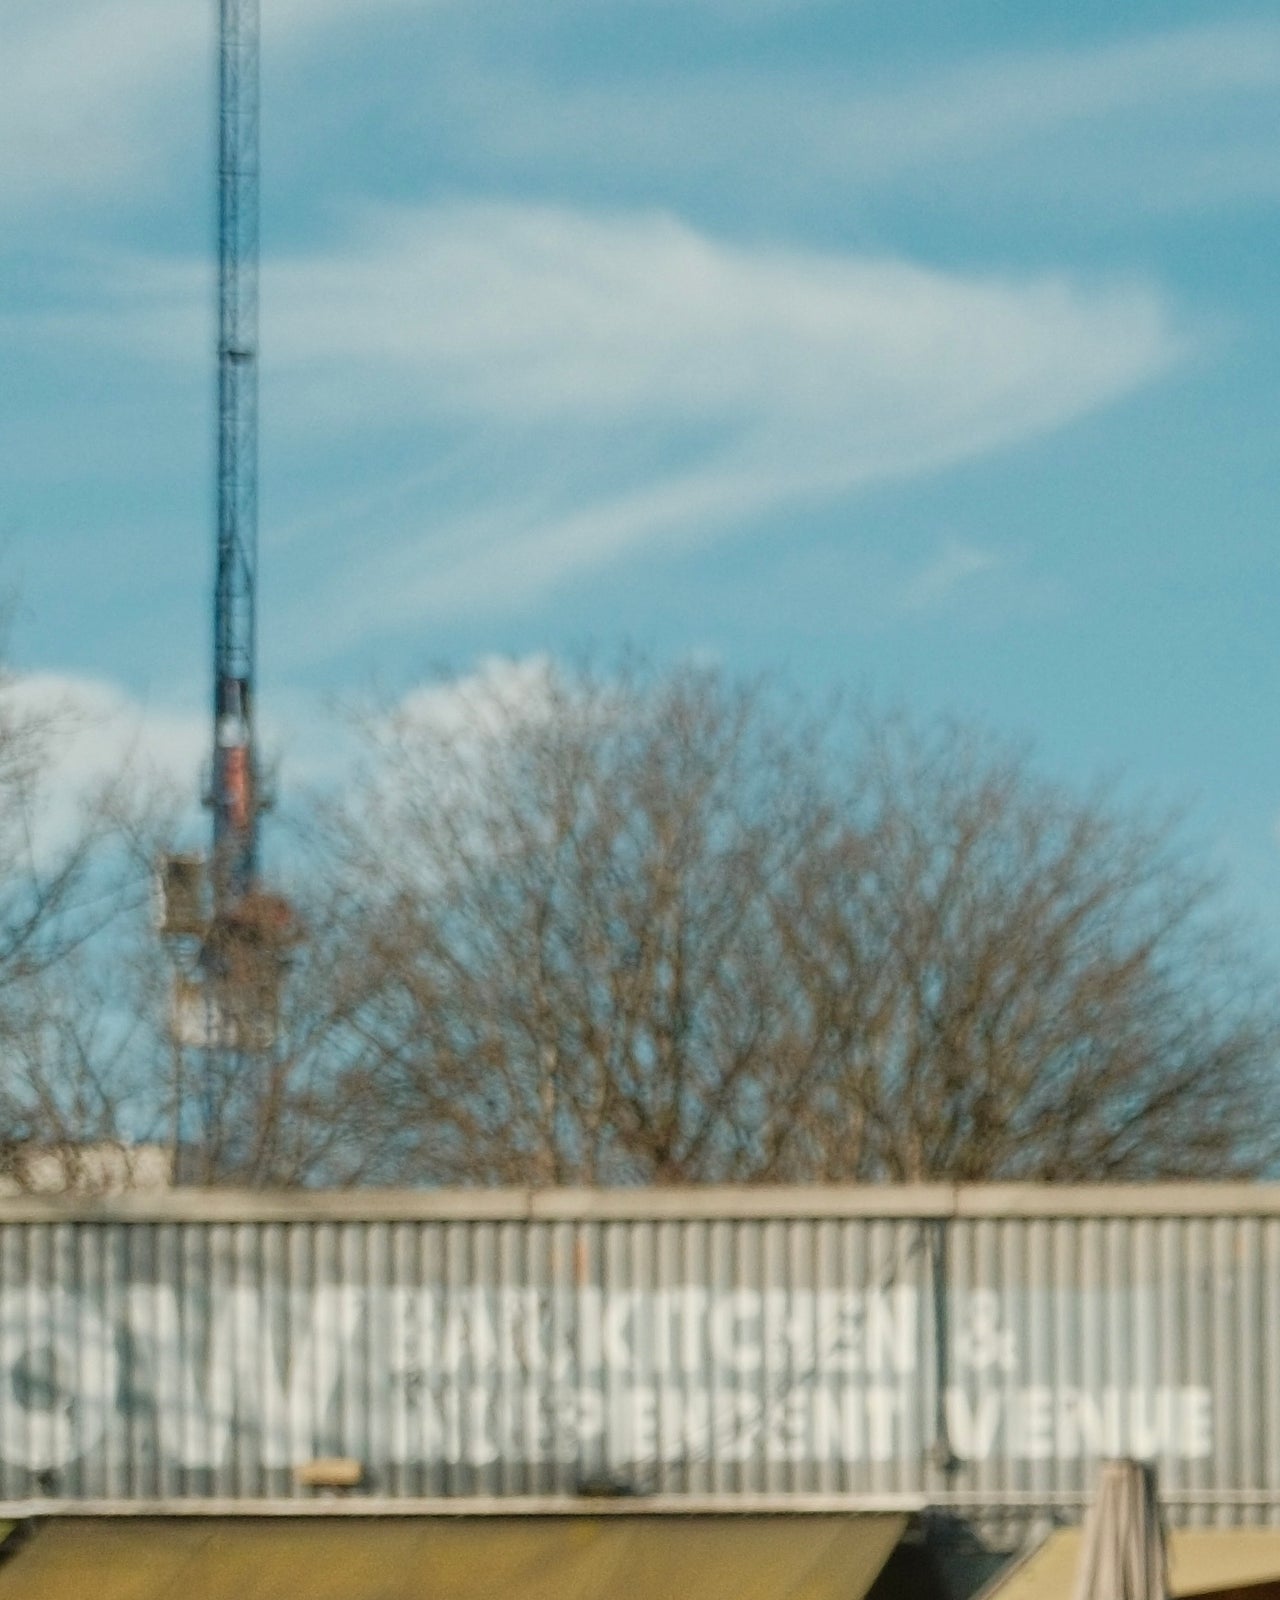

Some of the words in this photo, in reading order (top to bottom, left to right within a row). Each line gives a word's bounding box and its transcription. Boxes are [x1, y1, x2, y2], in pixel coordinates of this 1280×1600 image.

[577, 1284, 918, 1372] KITCHEN
[954, 1287, 1018, 1372] &
[943, 1382, 1213, 1463] VENUE
